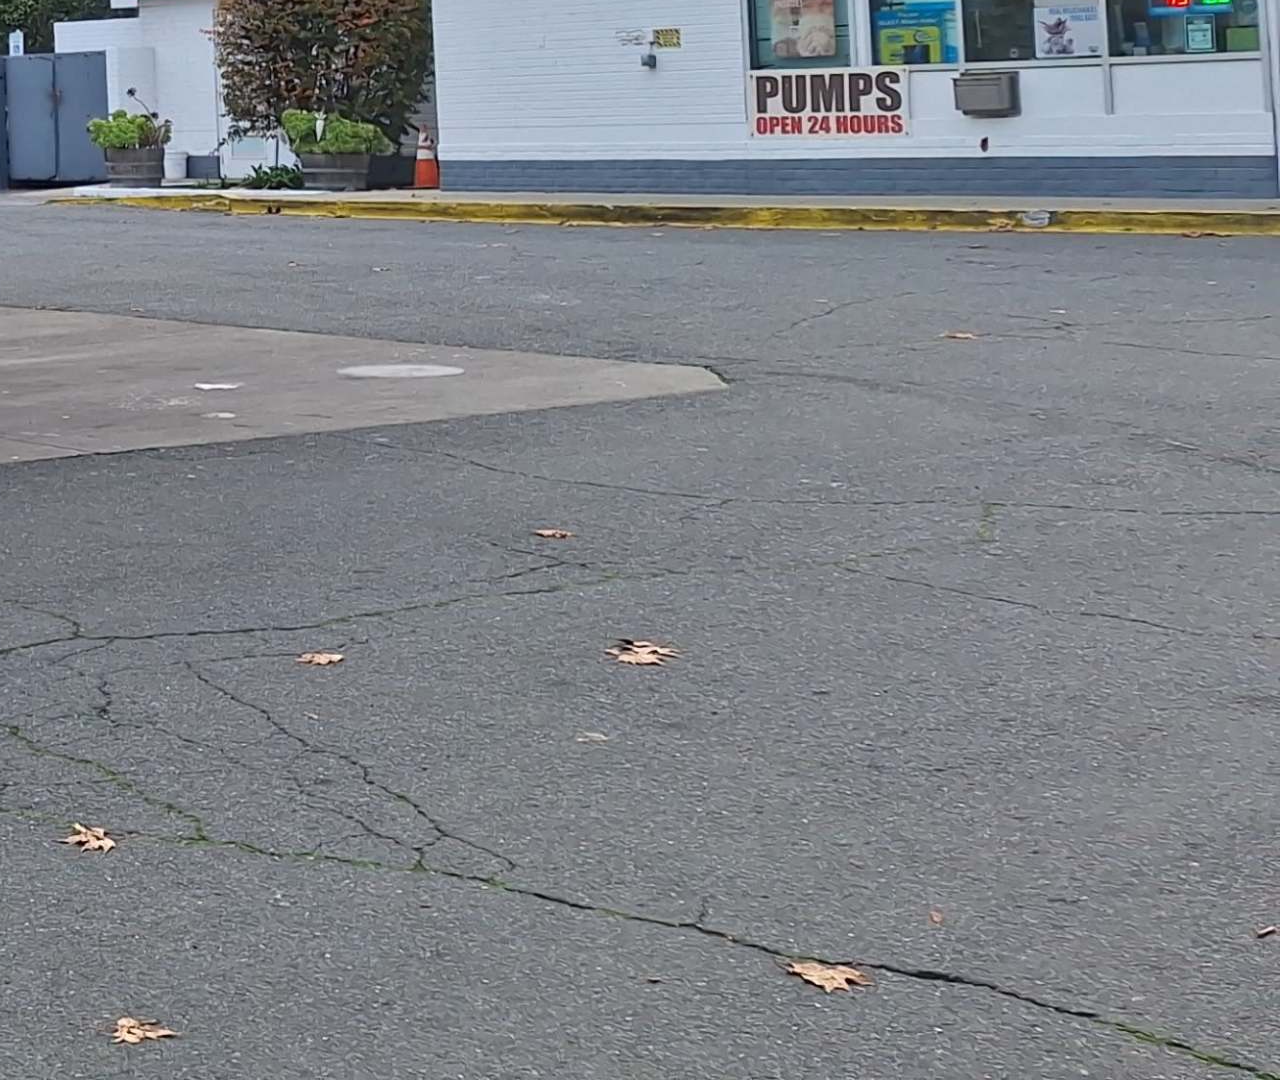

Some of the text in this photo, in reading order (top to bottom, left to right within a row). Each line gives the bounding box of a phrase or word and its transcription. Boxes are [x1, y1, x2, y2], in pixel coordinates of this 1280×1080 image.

[756, 71, 903, 114] PUMPS
[756, 114, 904, 135] OPEN 24 HOURS
